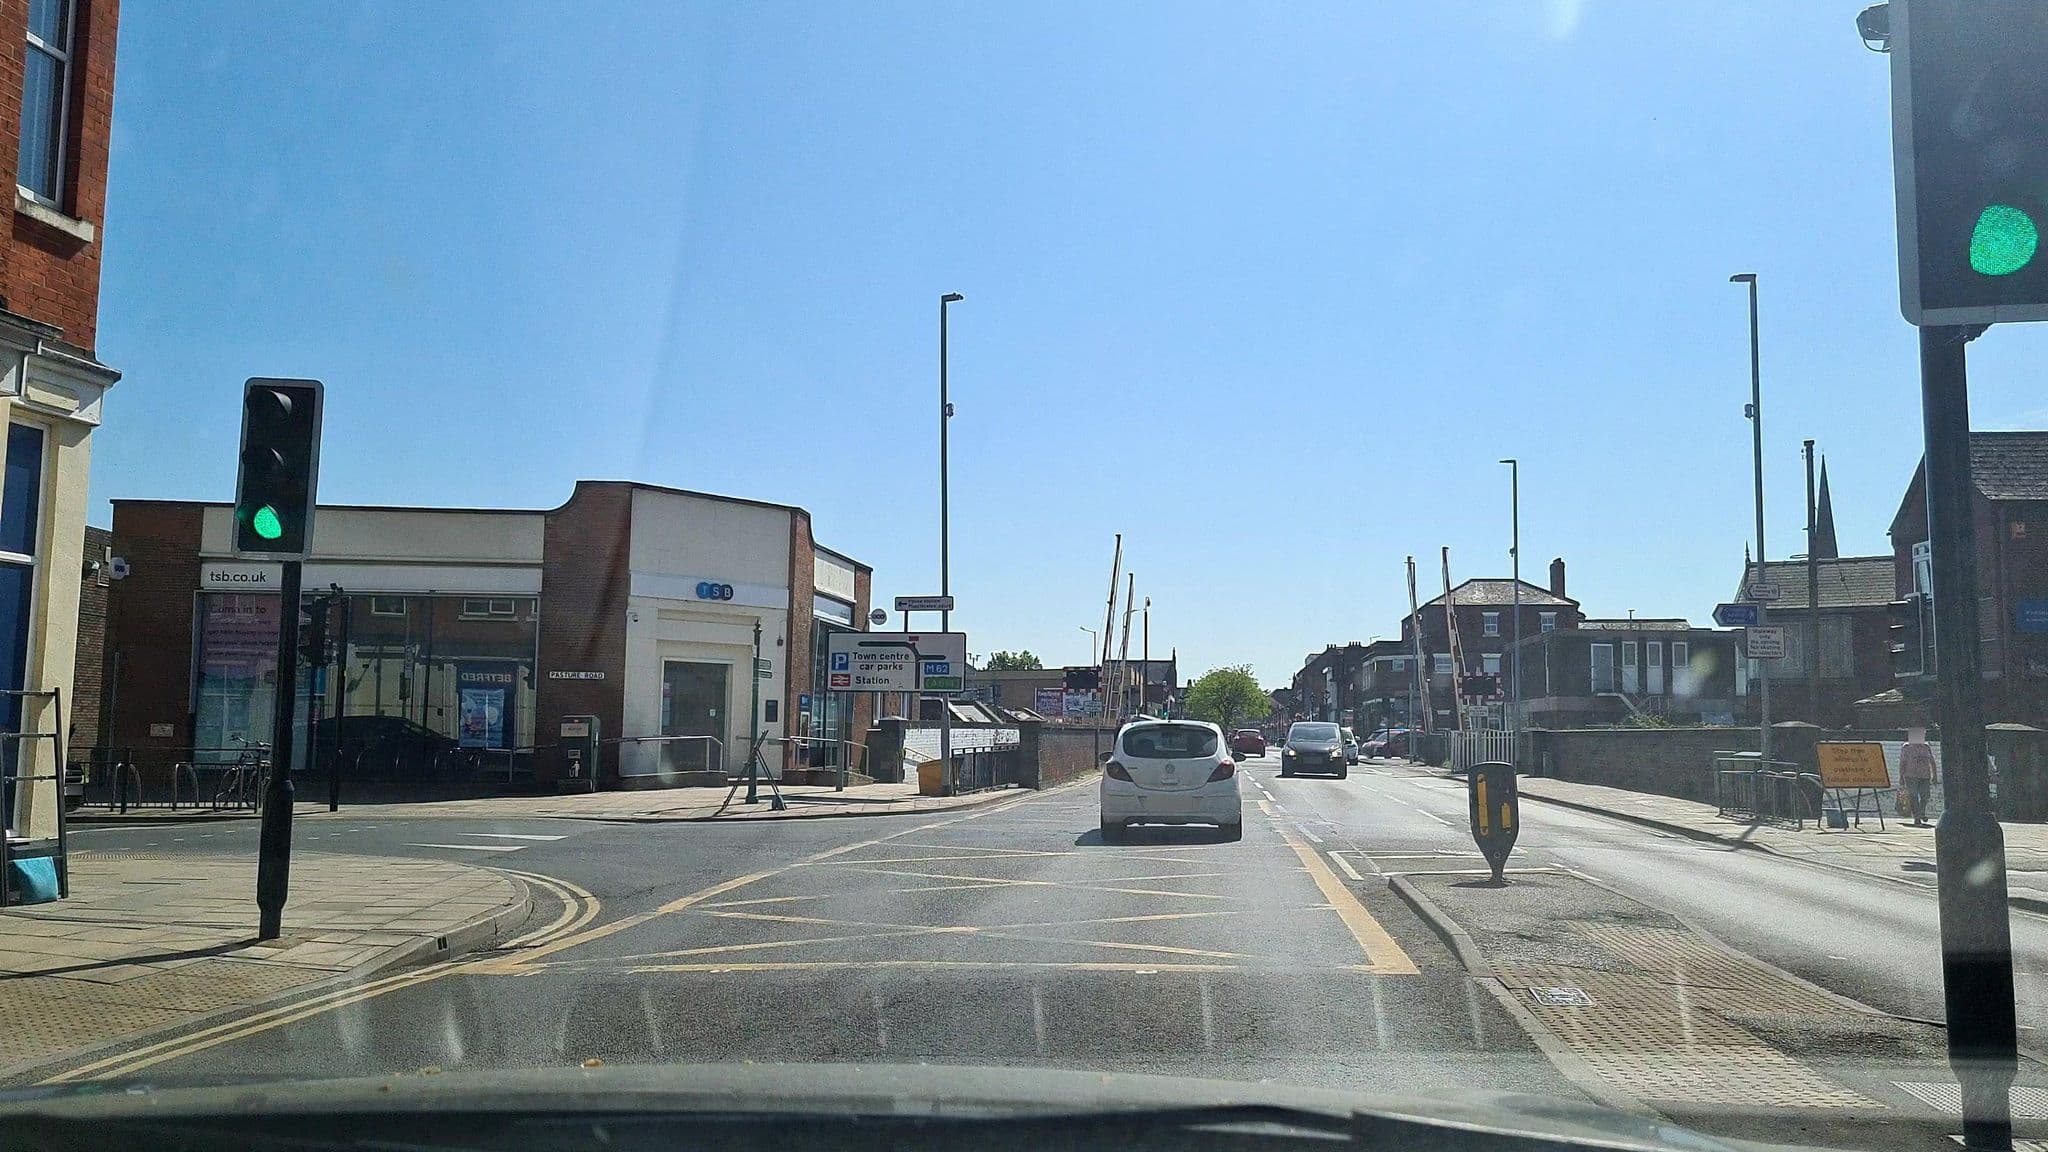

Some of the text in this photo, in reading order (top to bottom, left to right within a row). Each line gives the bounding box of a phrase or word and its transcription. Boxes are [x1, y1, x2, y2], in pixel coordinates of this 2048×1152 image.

[210, 571, 267, 582] tsb.co.uk
[700, 585, 731, 598] TSB
[852, 652, 910, 660] Town centre
[859, 662, 904, 672] car parks
[551, 671, 580, 679] PASTURE
[855, 676, 890, 685] Station
